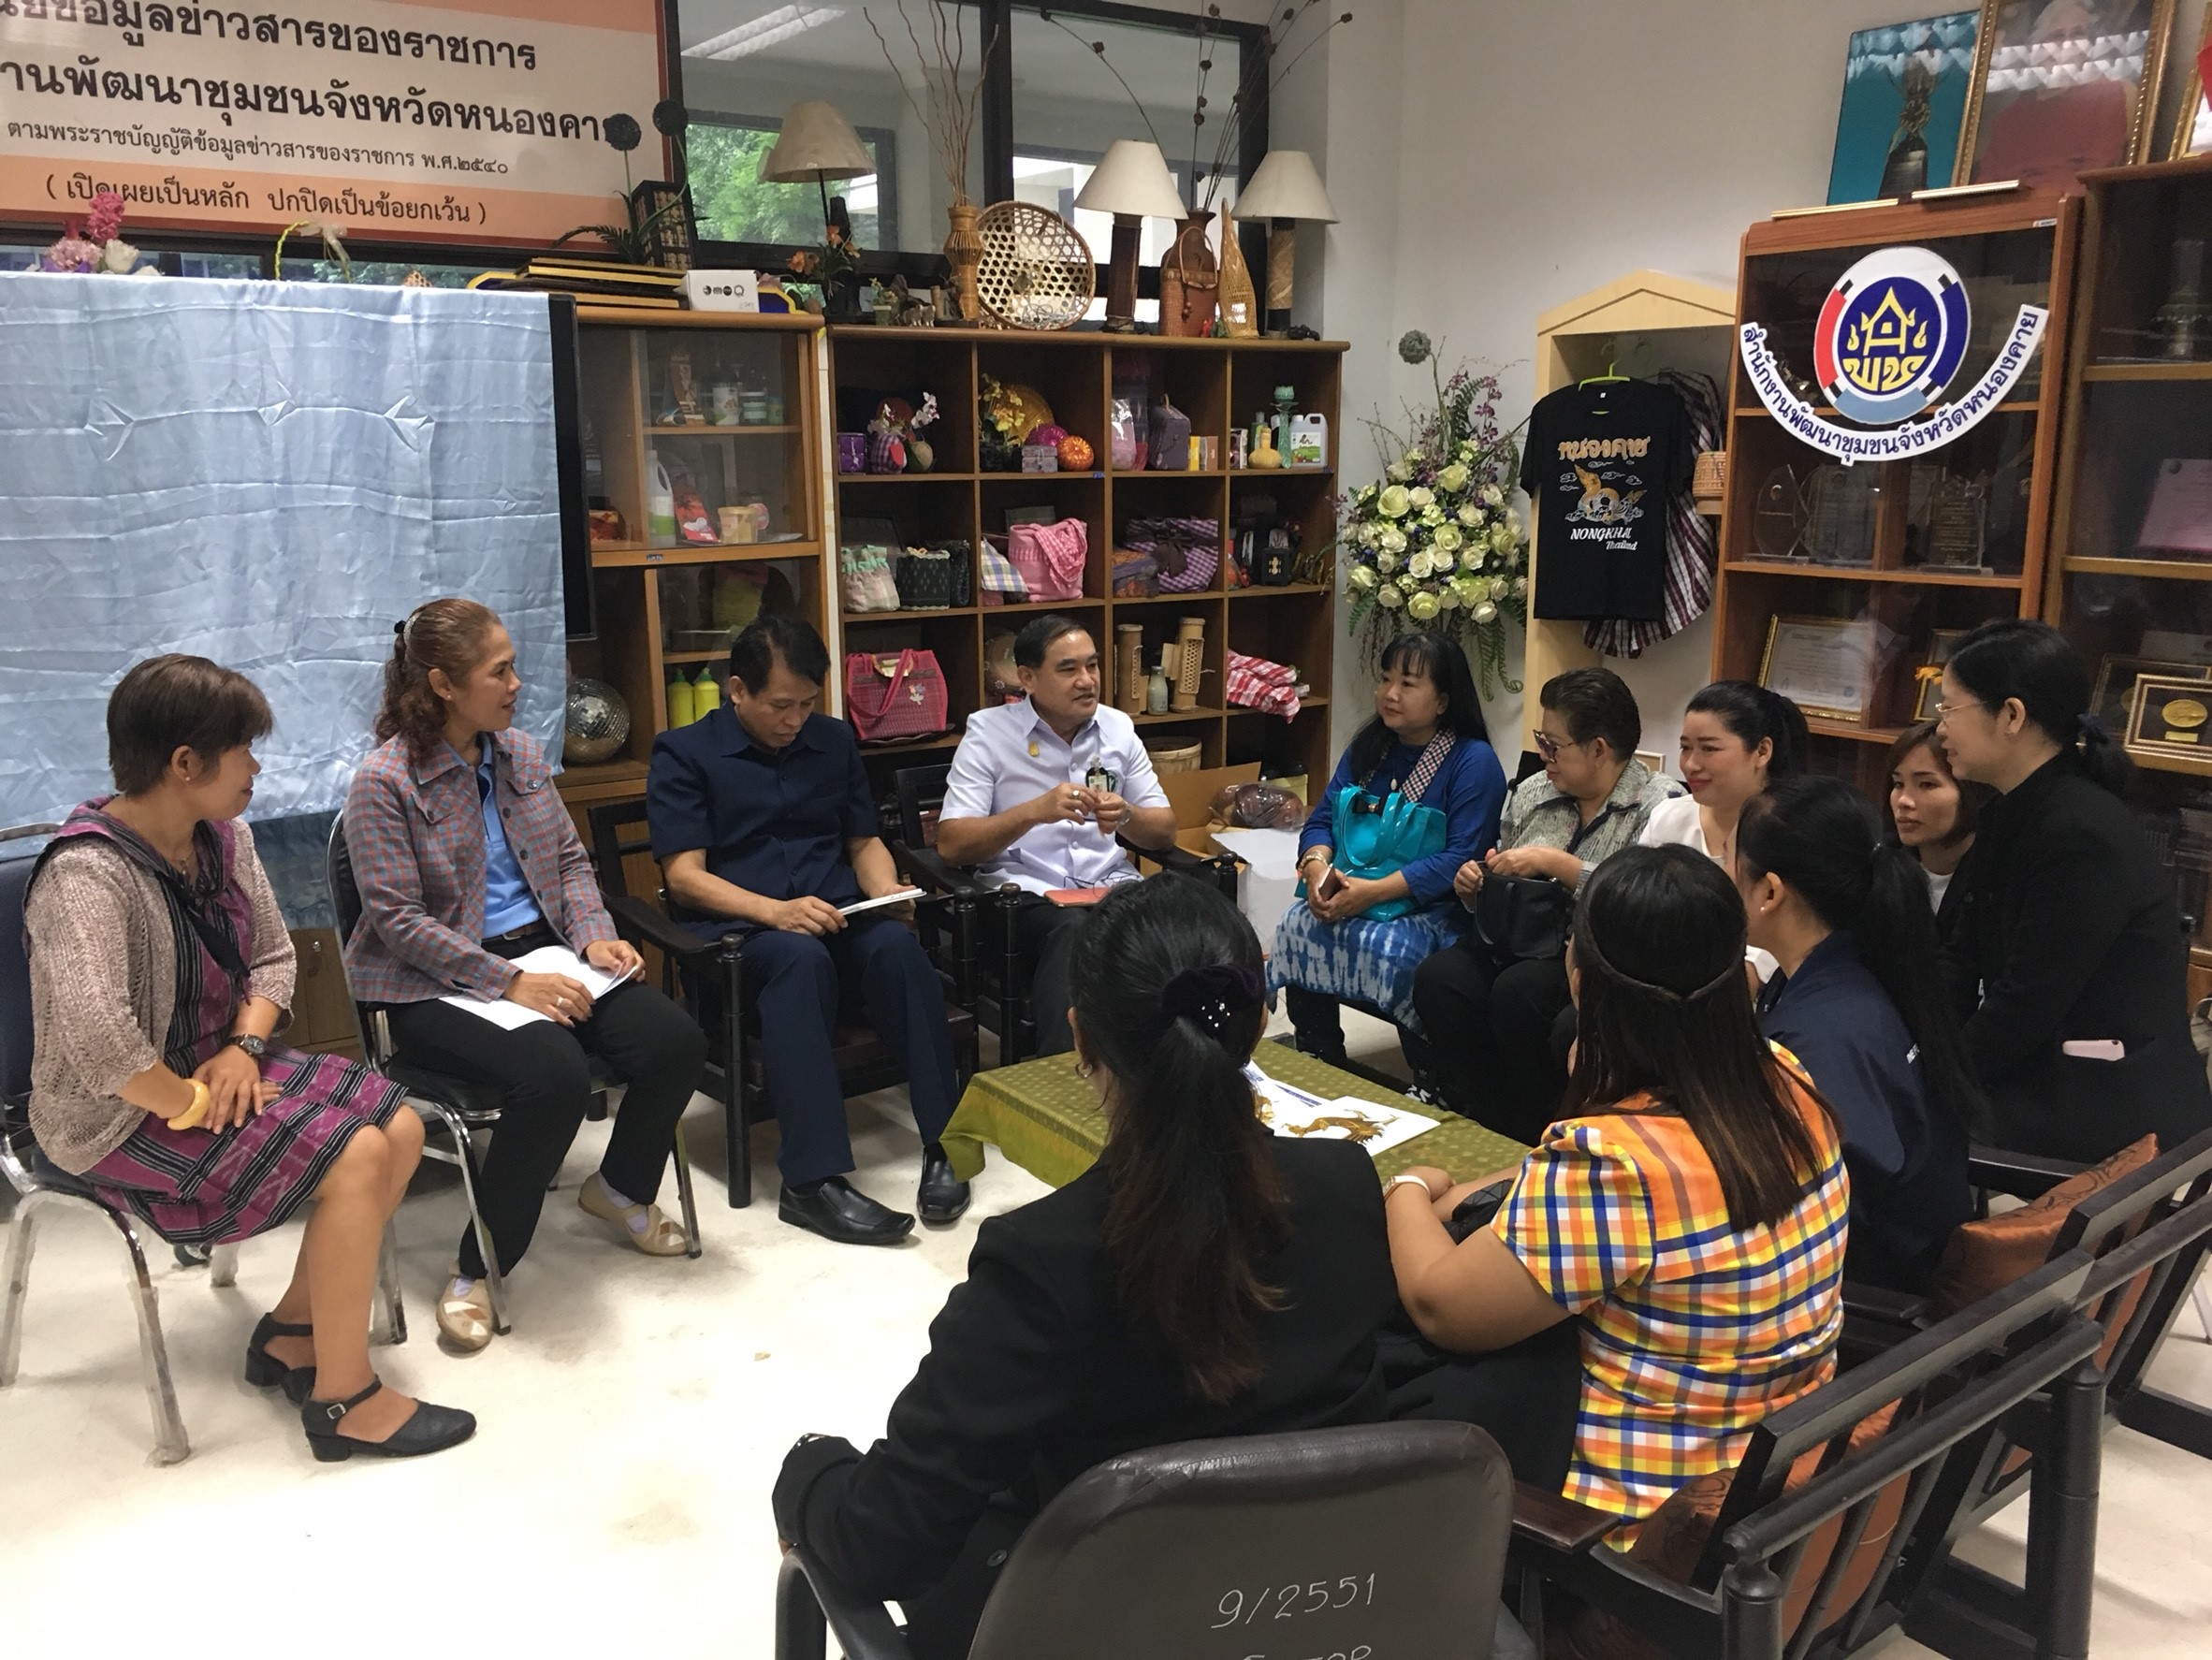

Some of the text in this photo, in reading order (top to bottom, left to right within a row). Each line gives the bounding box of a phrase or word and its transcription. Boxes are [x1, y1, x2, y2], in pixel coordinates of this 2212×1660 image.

[0, 54, 608, 142] านพัฒนาชุมชนจังหวัดหนองคา
[421, 152, 509, 175] พ.ศ.๒๕๔๐
[268, 186, 470, 223] ปกปิดเป็นข้อยกเว้น
[1743, 312, 2039, 462] สำนักงานพัฒนาชุมชนจังหวัดหนองคาย
[1211, 1573, 1375, 1628] 9/2551
